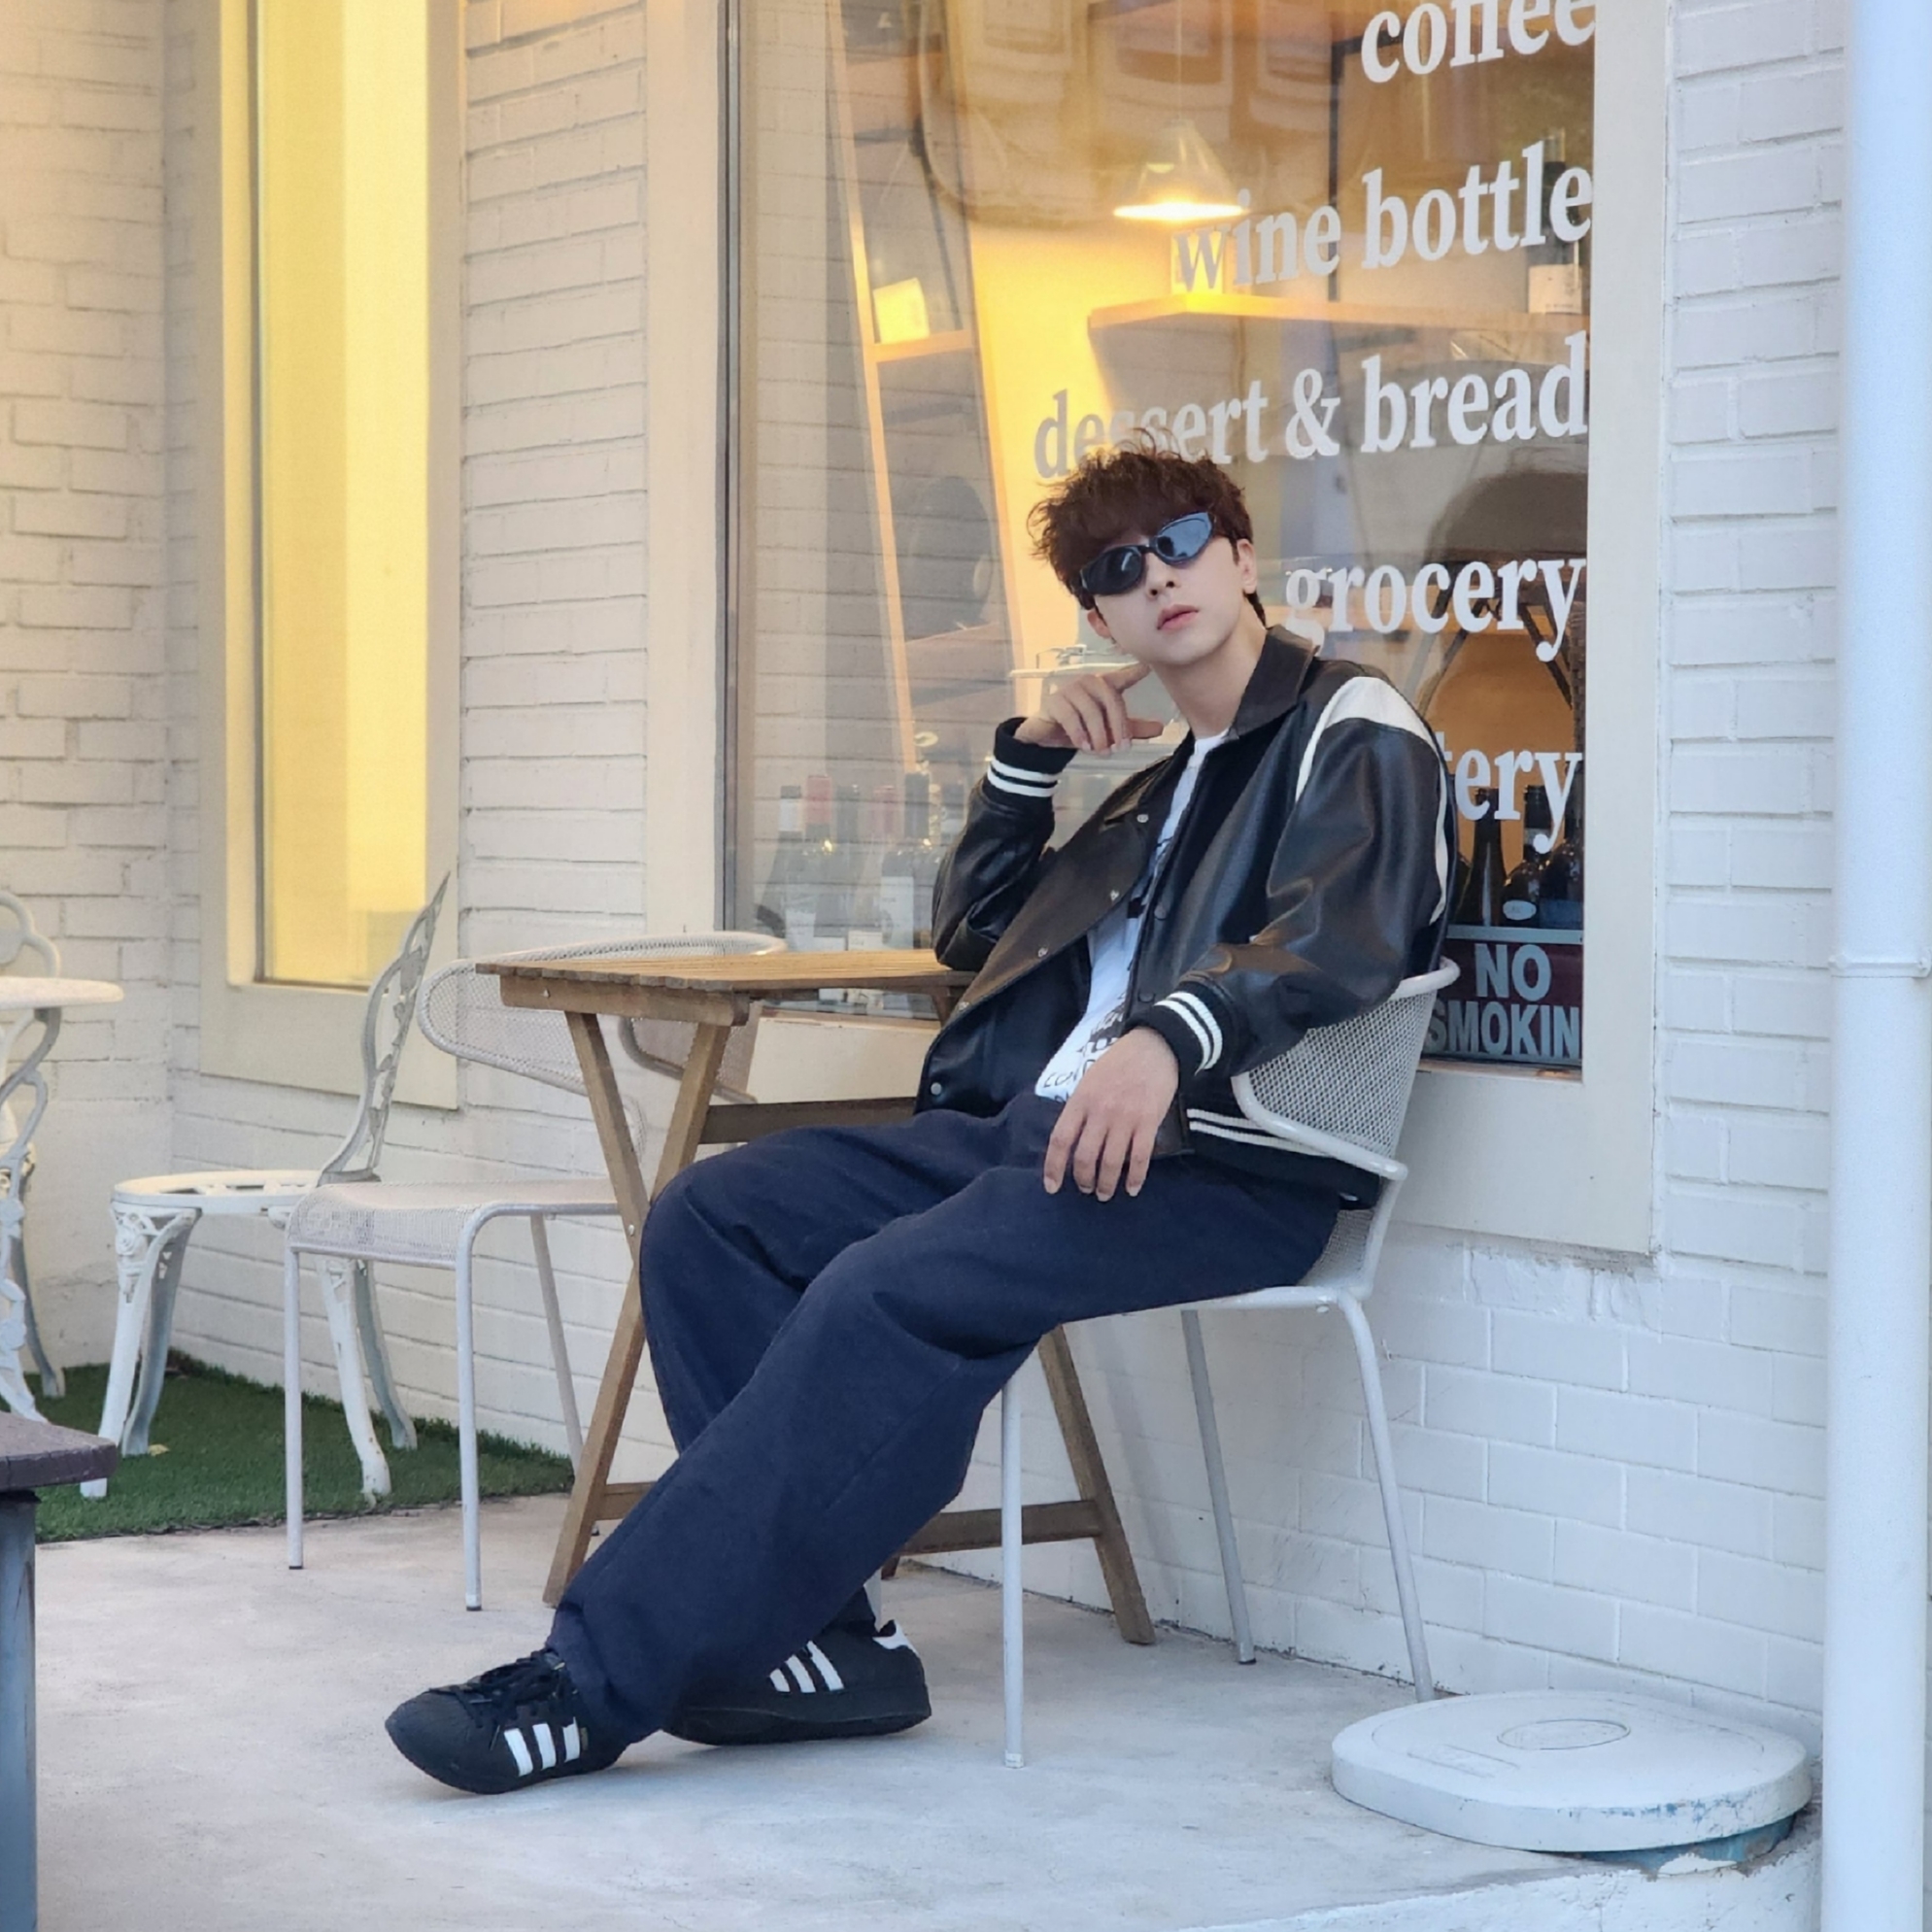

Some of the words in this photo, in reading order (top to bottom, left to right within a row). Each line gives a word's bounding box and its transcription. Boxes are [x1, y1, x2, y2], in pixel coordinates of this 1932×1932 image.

[1172, 187, 1341, 293] wine
[1361, 140, 1593, 270] bottle
[1285, 368, 1341, 460] &
[1361, 331, 1588, 454] bread
[1285, 559, 1586, 662] grocery
[1474, 942, 1552, 1002] NO
